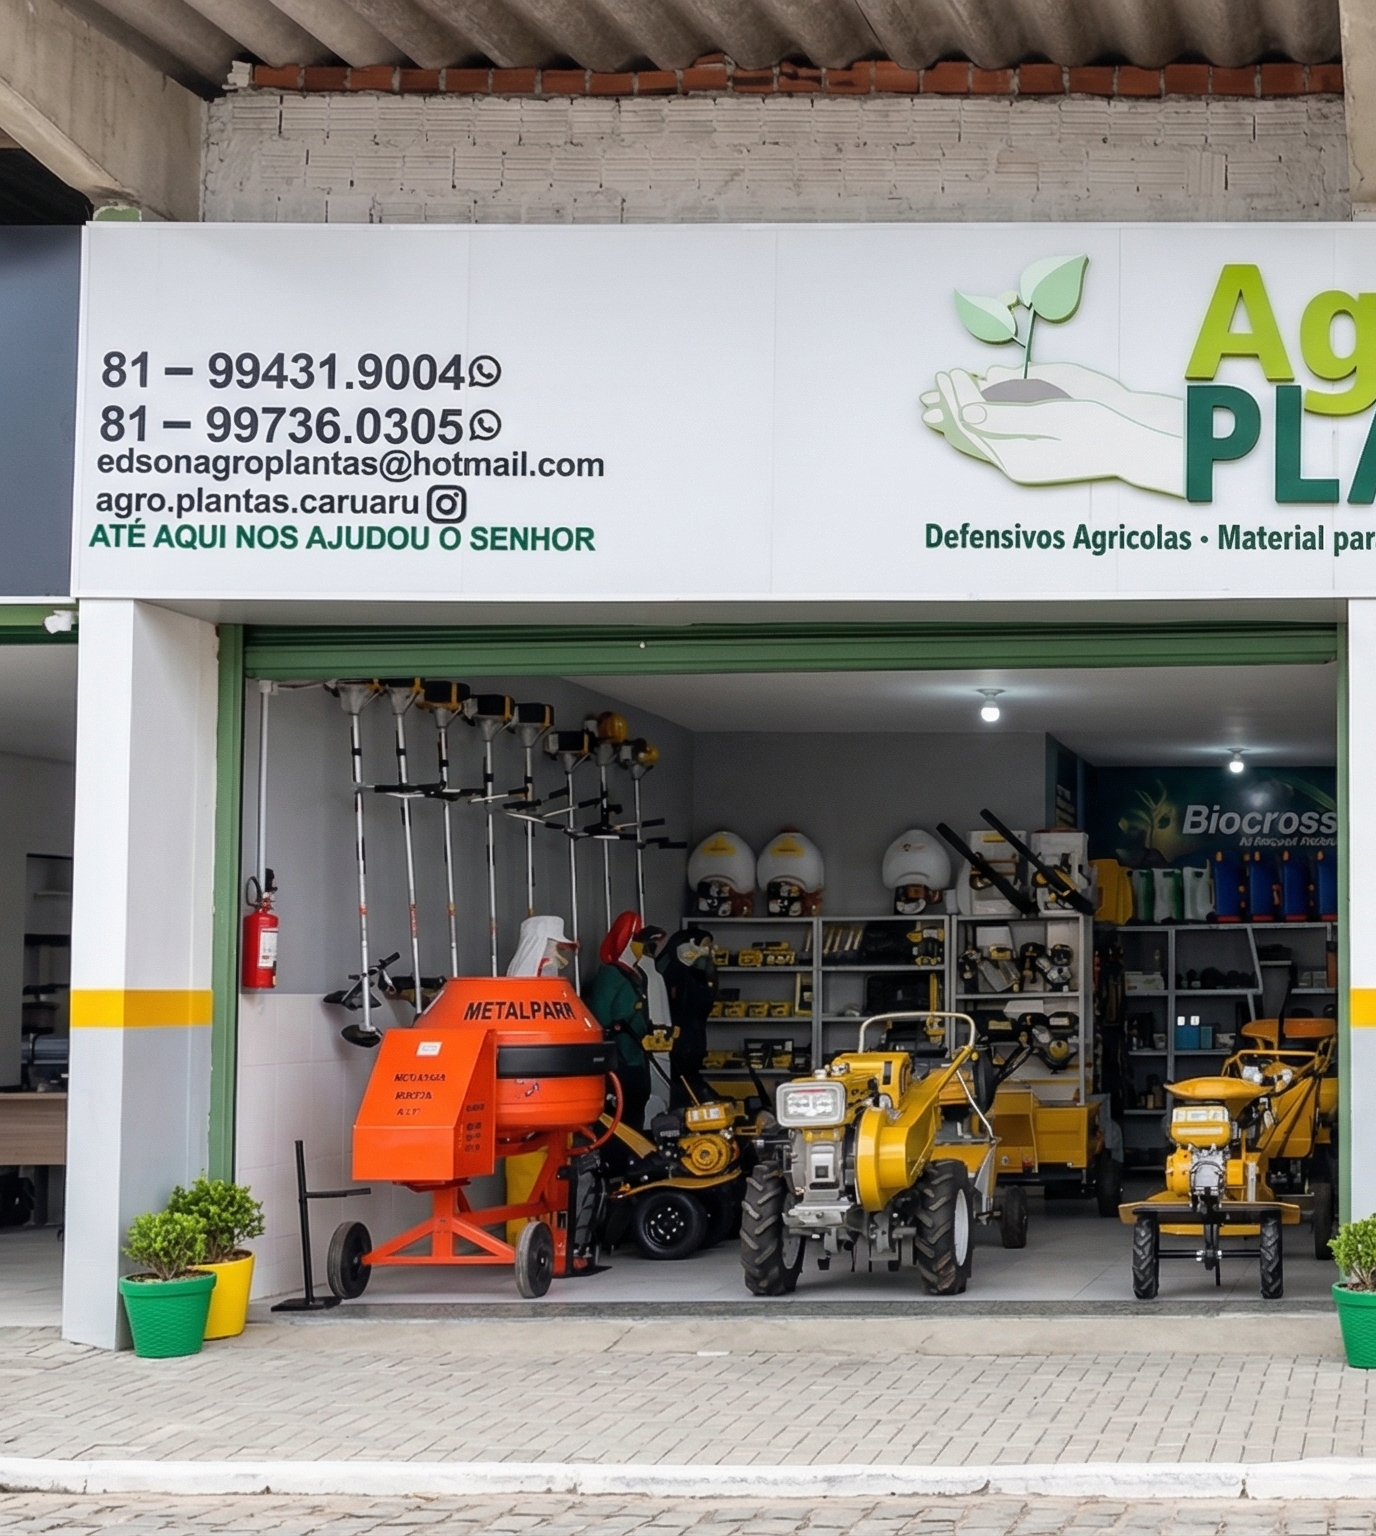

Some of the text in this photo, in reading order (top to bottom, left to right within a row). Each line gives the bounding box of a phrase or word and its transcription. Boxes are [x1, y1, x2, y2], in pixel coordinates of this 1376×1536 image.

[102, 352, 148, 388] 81
[208, 353, 466, 390] 99431.9004
[100, 406, 146, 442] 81
[206, 407, 464, 445] 99736.0305
[97, 448, 605, 482] edsonagroplantas@hotmail.com
[96, 487, 419, 517] agro.plantas.caruaru
[89, 519, 596, 552] ATÉ AQUI NOS AJUDOU O SENHOR
[925, 523, 1066, 550] Defensivos
[1073, 523, 1192, 557] Agricolas
[1218, 524, 1324, 551] Material
[1182, 804, 1337, 835] Biocross
